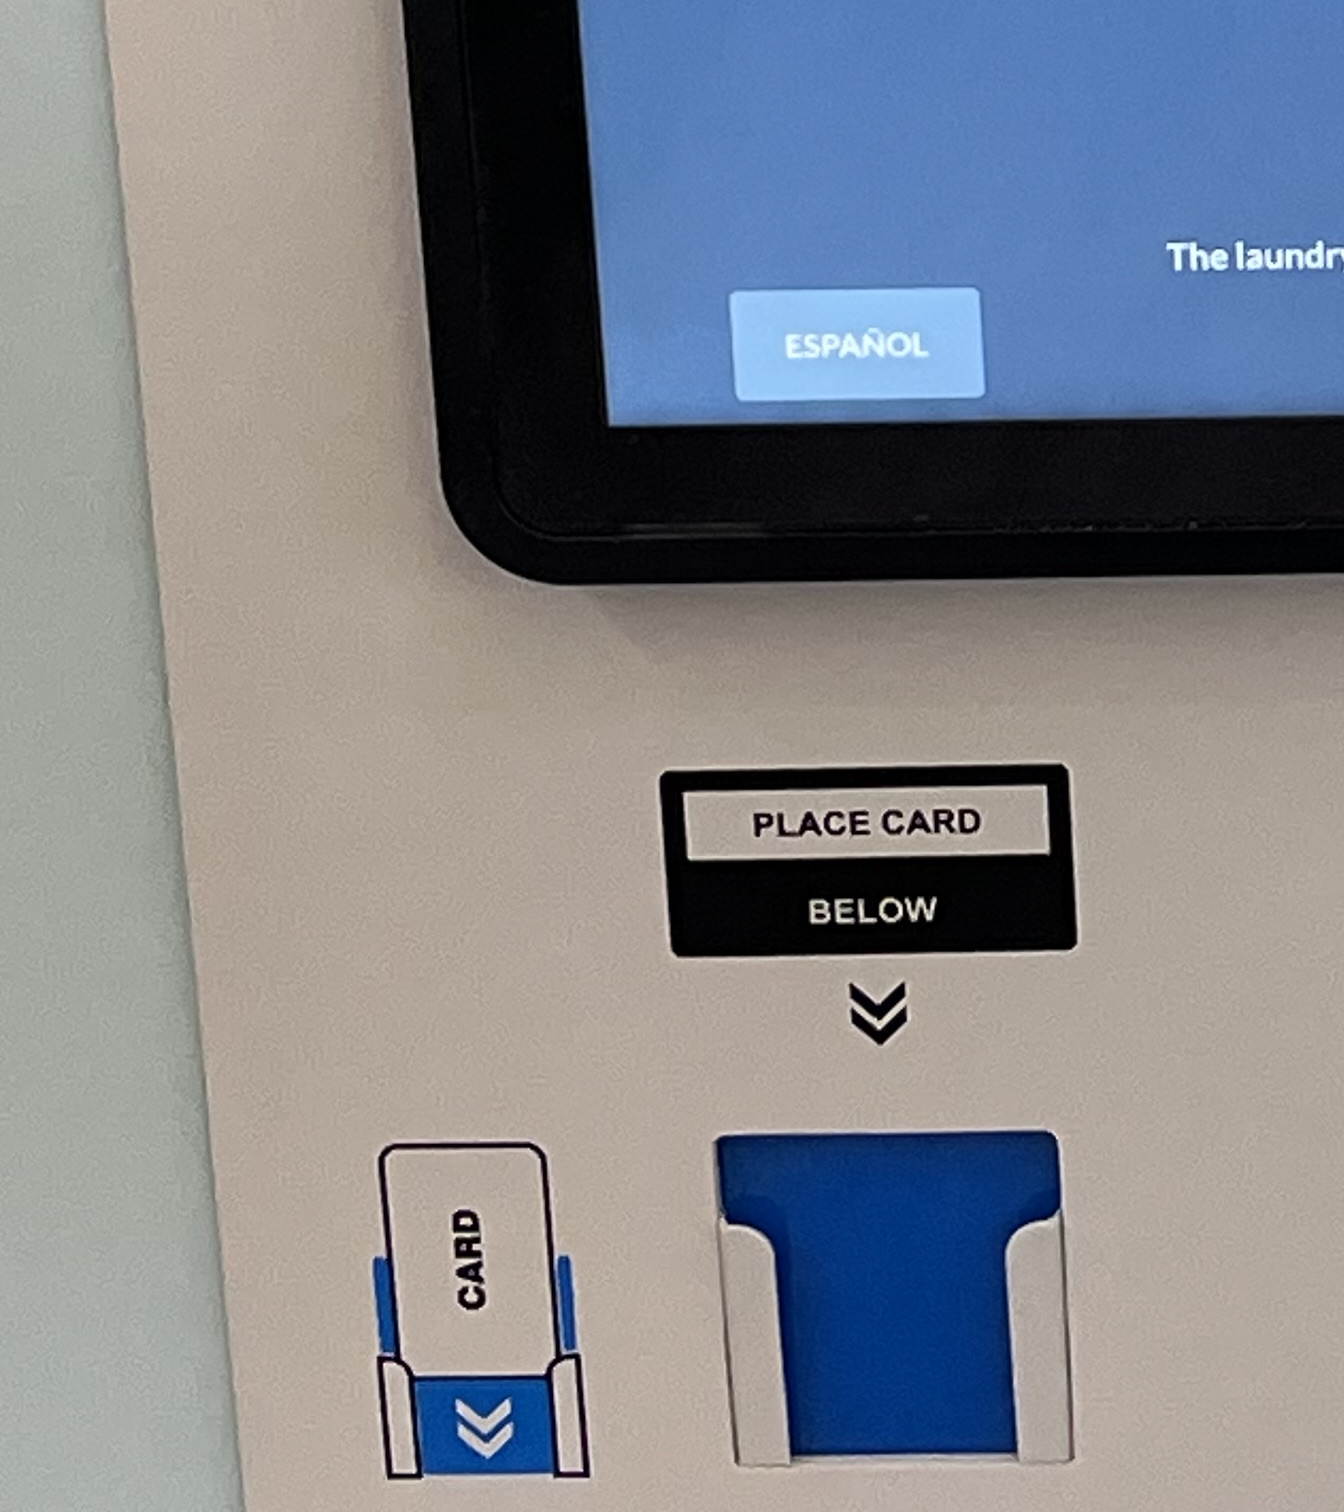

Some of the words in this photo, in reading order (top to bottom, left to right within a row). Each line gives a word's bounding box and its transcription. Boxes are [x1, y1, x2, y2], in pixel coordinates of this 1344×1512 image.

[1165, 241, 1230, 272] The
[784, 326, 930, 360] ESPAÑOL
[752, 809, 872, 839] PLACE
[880, 807, 982, 836] CARD
[808, 895, 939, 925] BELOW
[451, 1208, 487, 1312] CARD
